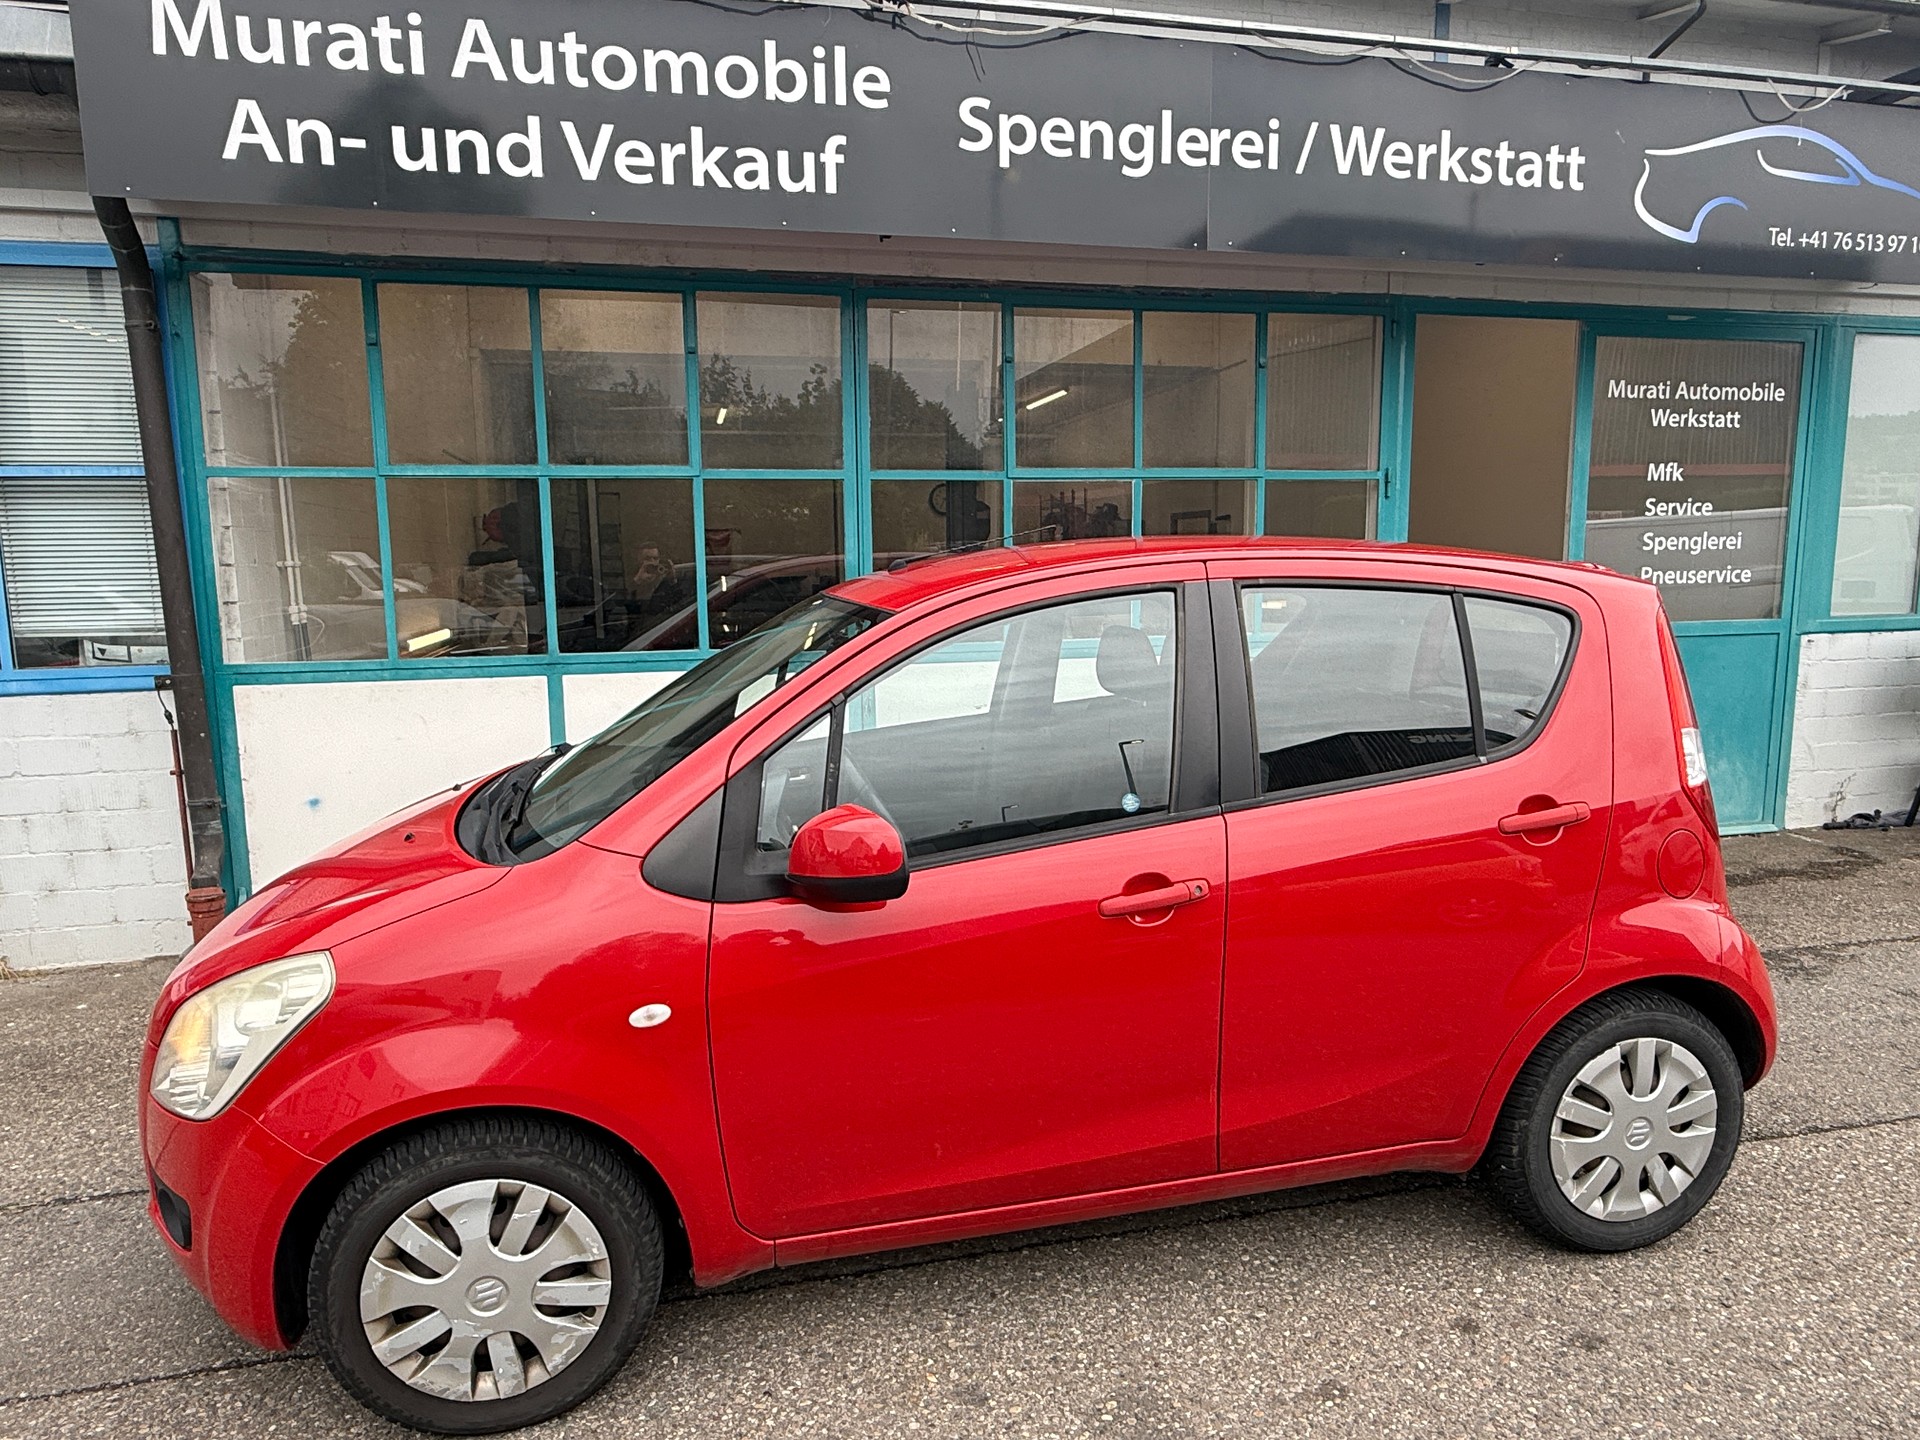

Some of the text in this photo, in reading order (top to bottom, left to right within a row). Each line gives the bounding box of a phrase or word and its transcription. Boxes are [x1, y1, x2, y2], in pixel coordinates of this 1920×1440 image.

[151, 0, 892, 110] Murati Automobile
[221, 98, 847, 195] An- und Verkauf
[958, 96, 1586, 192] Spenglerei / Werkstatt
[1768, 227, 1920, 254] Tel. +41 76 513 97 1
[1607, 379, 1786, 402] Murati Automobile
[1650, 408, 1742, 429] Werkstatt
[1647, 462, 1685, 482] Mfk
[1644, 497, 1713, 517] Service
[1642, 531, 1743, 555] Spenglerei
[1640, 564, 1752, 585] Pneuservice
